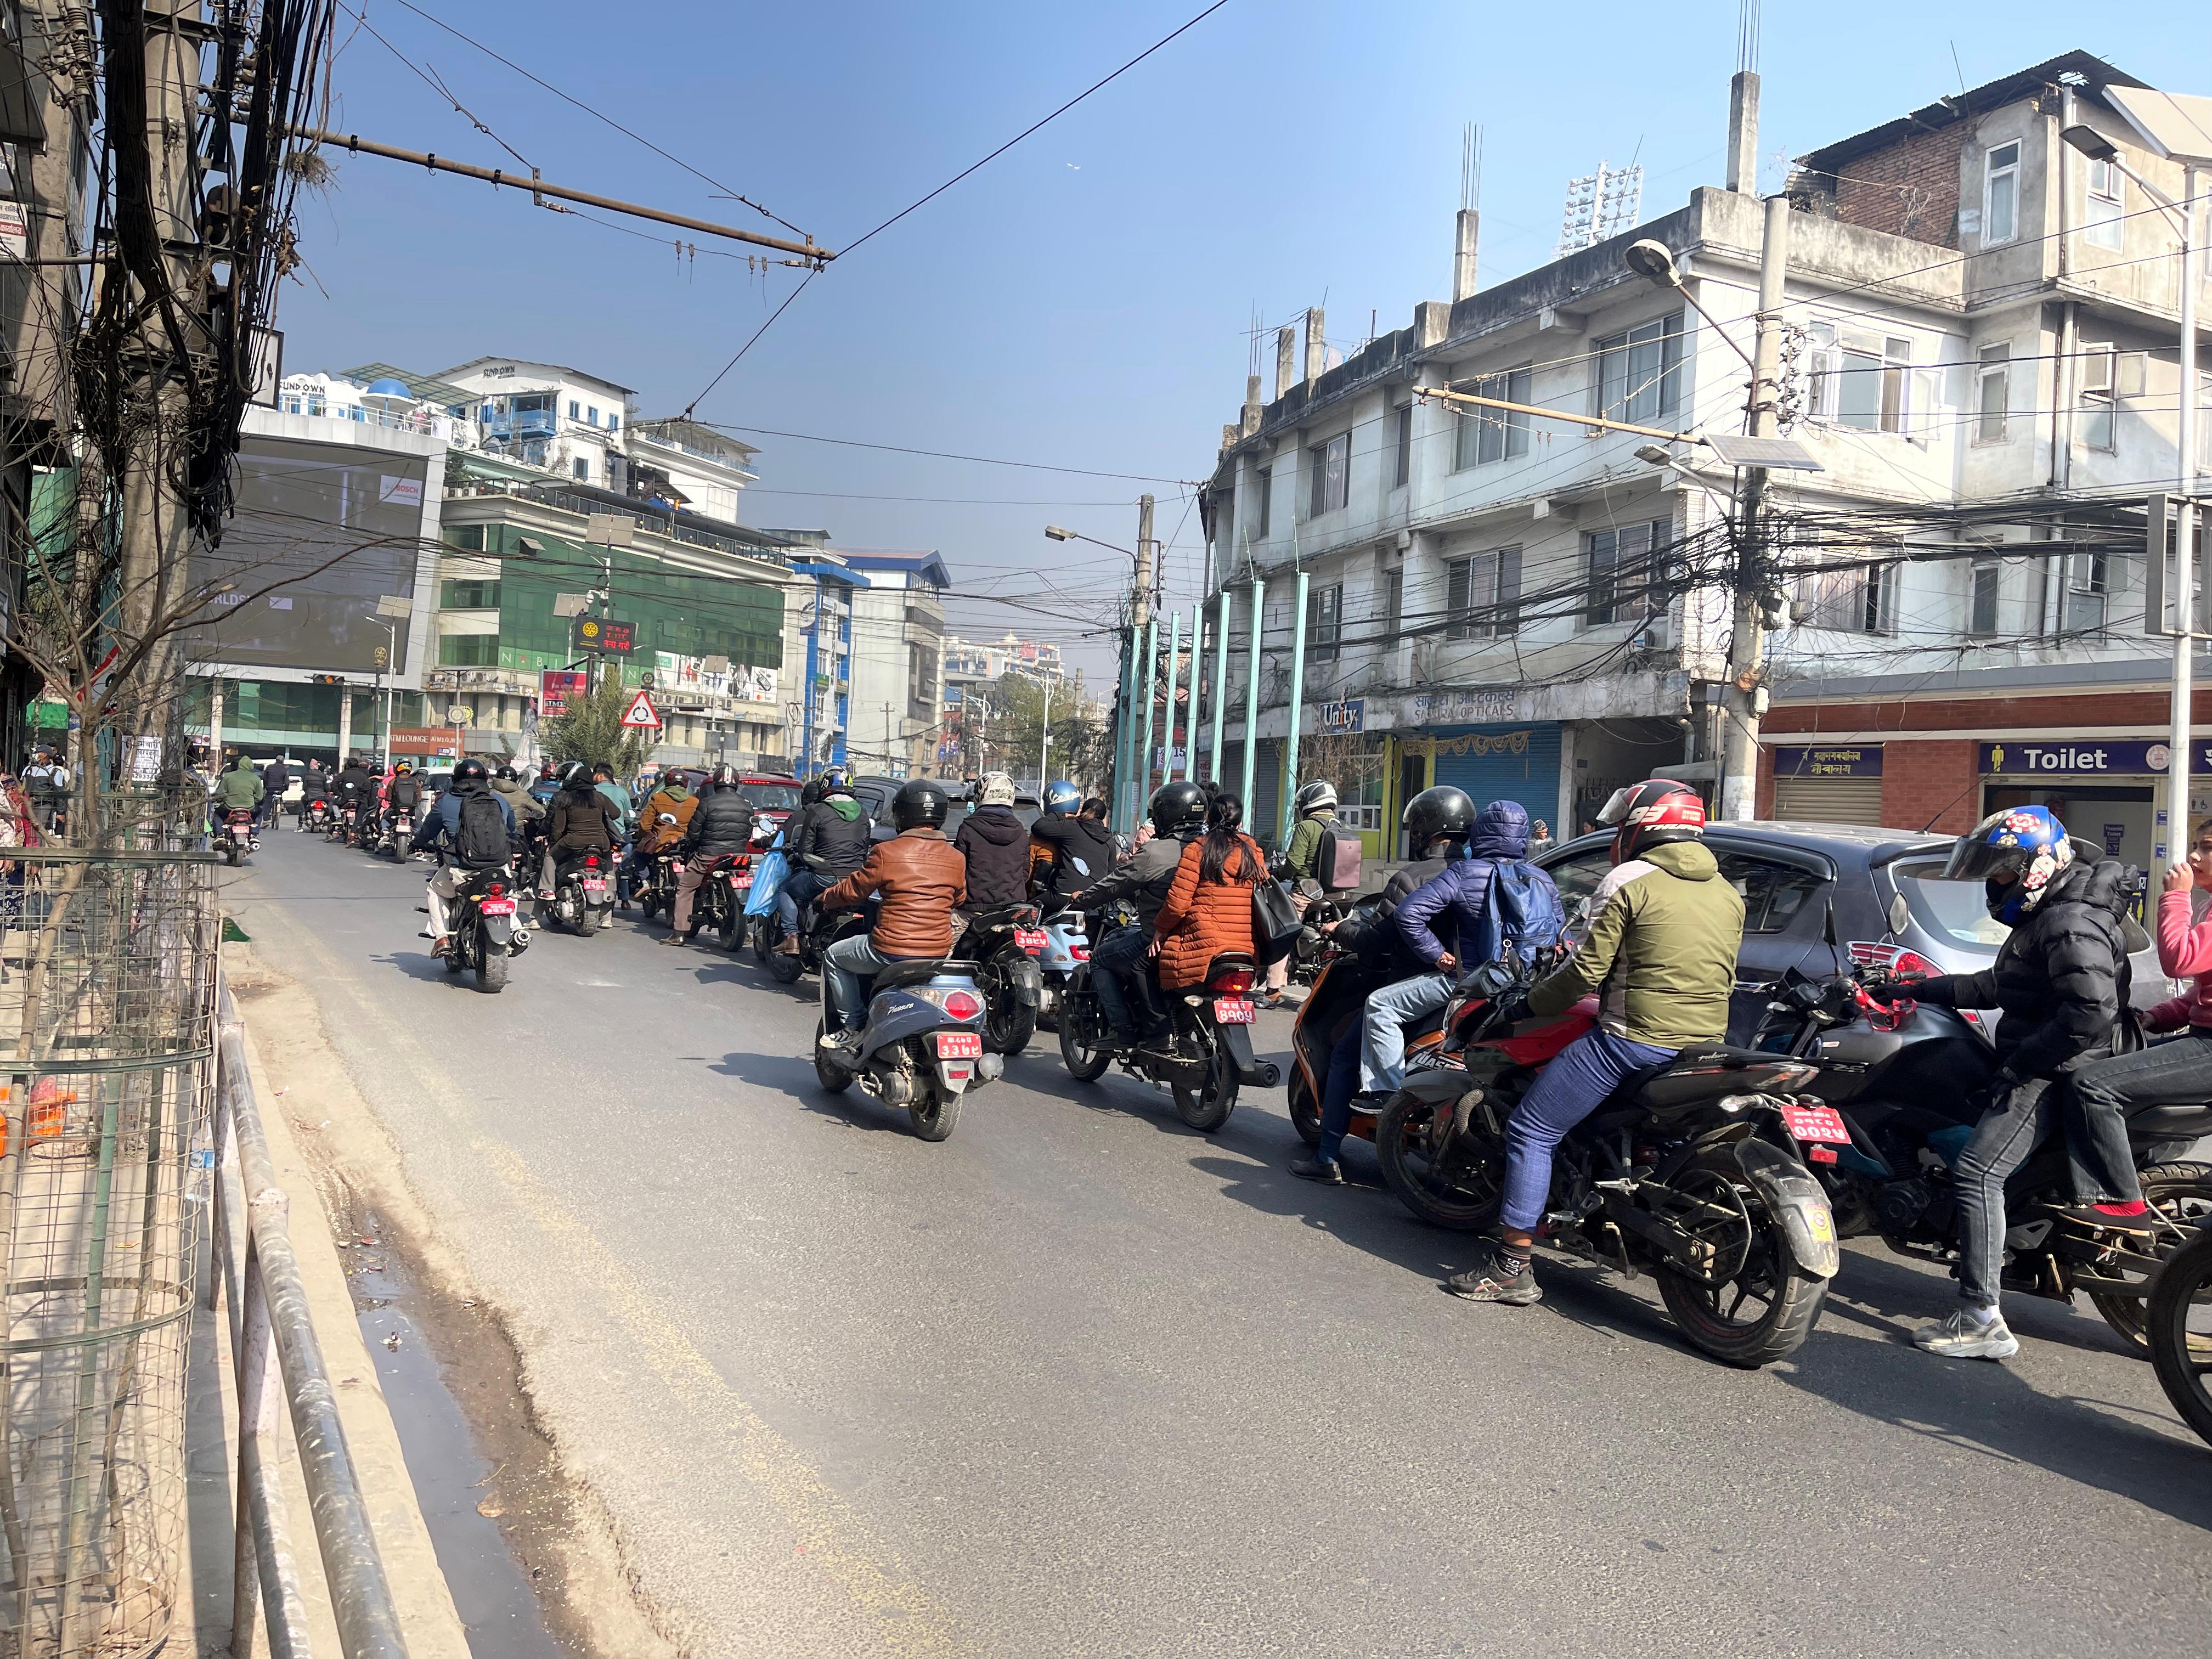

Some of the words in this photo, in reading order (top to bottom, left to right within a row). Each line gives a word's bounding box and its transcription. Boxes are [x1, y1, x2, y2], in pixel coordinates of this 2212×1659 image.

[395, 485, 419, 493] BOSCH
[1323, 704, 1357, 730] Unity
[402, 735, 428, 743] LOUNGE
[2024, 748, 2107, 769] Toilet
[1049, 789, 1081, 805] Vespa
[1625, 806, 1668, 827] 93
[887, 1003, 914, 1016] Pleasure
